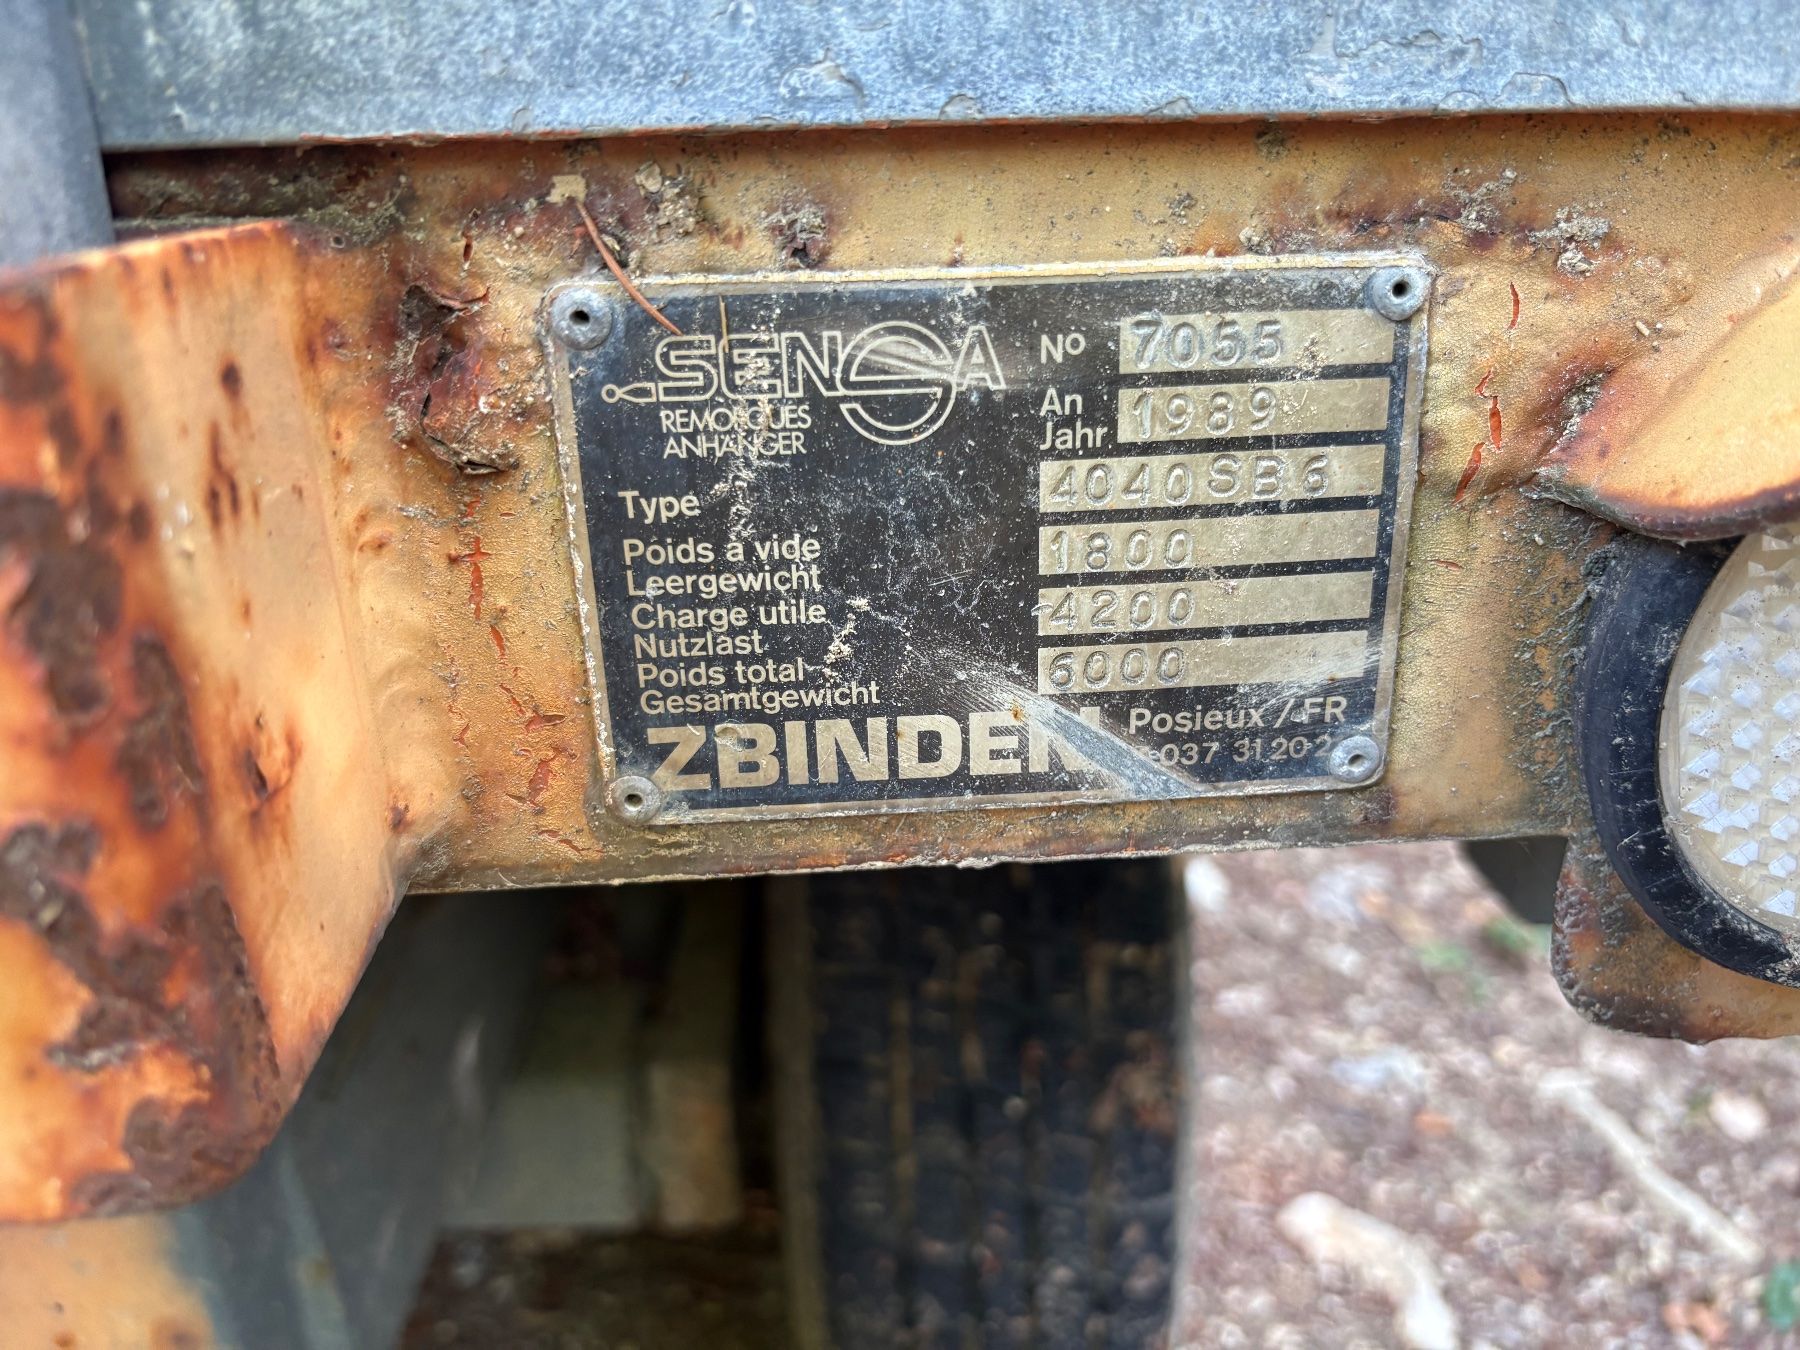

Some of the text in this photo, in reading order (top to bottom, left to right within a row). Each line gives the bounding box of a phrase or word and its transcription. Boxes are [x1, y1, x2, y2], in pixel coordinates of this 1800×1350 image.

[1131, 317, 1284, 370] 7055
[1040, 388, 1083, 416] An
[1132, 387, 1278, 440] 1989
[1040, 422, 1108, 451] Jahr
[618, 490, 700, 524] Type
[623, 538, 715, 566] Poids
[754, 533, 822, 561] vide
[1049, 527, 1194, 574] 1800
[627, 565, 823, 598] Leergewicht
[631, 587, 1196, 633] Charge utile 4200
[634, 629, 764, 659] Nutzlast
[638, 646, 1187, 692] Poids total 6000
[640, 680, 881, 716] Gesamtgewicht
[1129, 705, 1265, 735] Posieux
[1303, 695, 1348, 725] FR
[1160, 741, 1220, 767] 037
